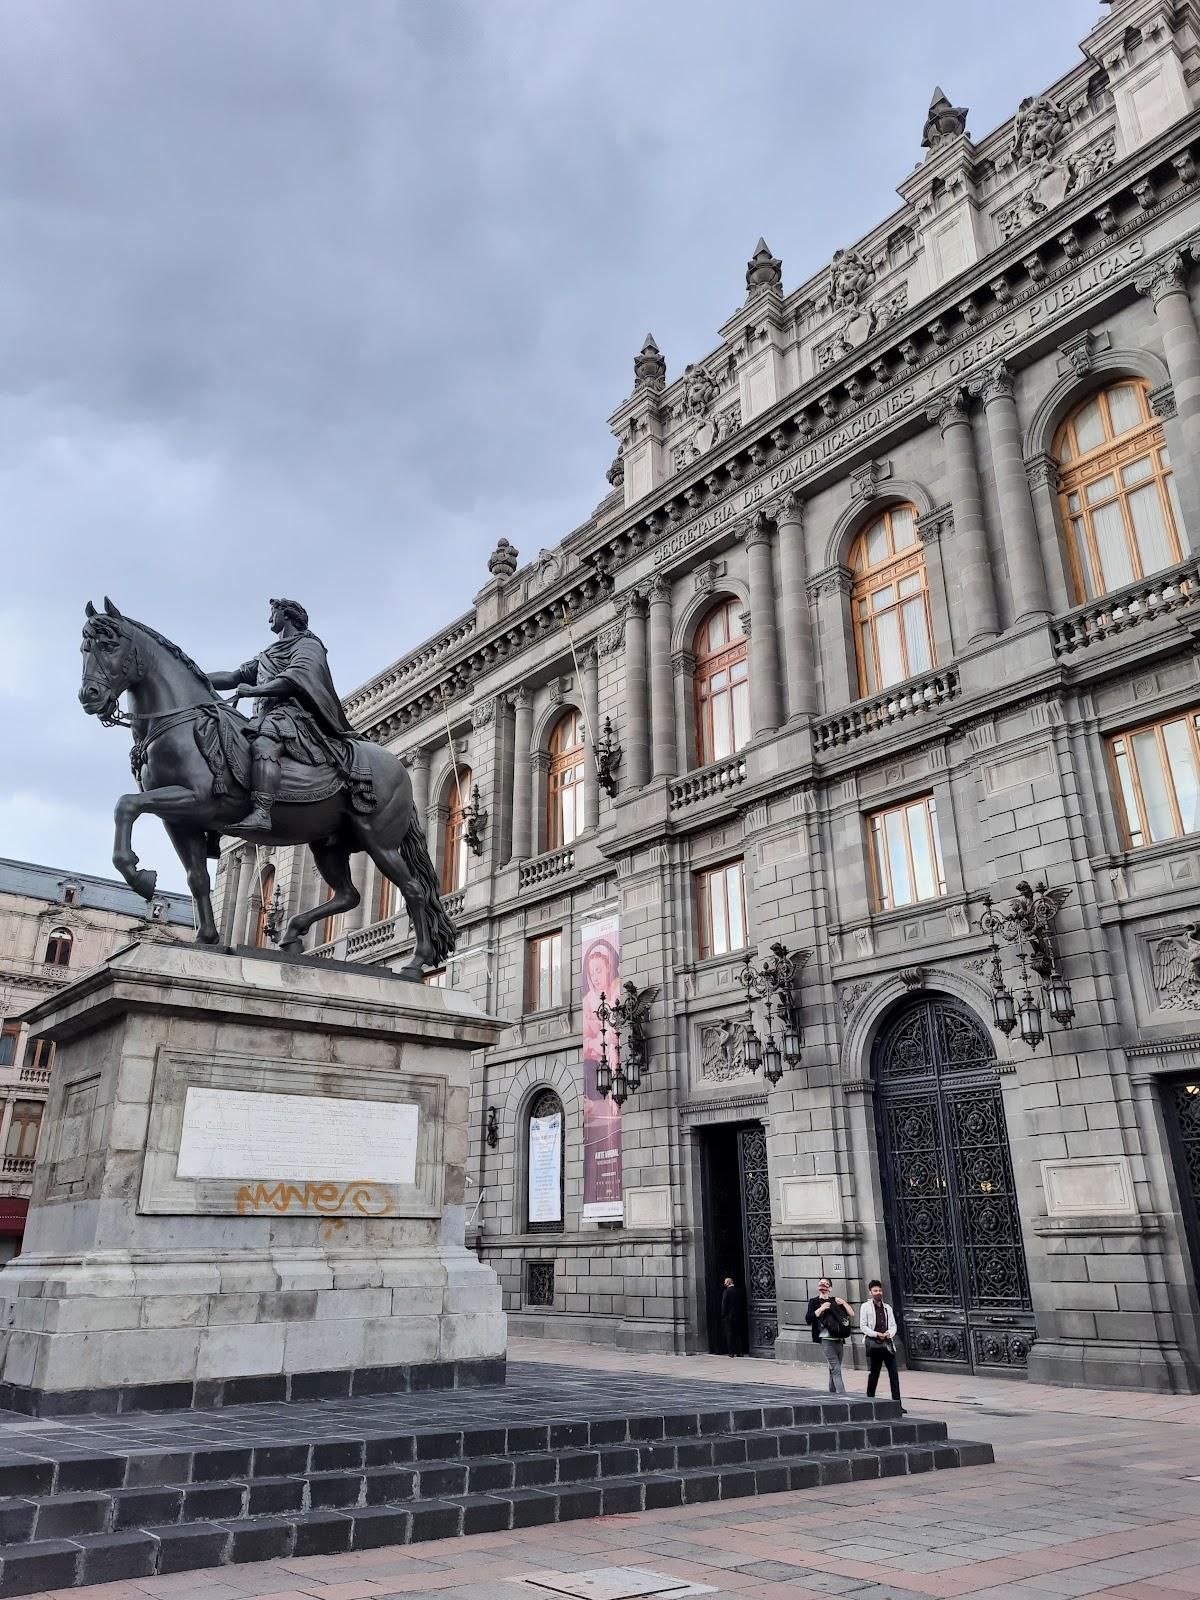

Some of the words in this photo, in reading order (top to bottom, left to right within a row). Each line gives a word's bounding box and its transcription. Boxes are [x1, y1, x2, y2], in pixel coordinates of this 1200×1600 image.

[654, 501, 737, 565] SECRETARIA
[743, 483, 764, 509] DE
[769, 385, 915, 490] COMUNICACIONES
[926, 368, 938, 391] Y
[948, 319, 1017, 377] OBRAS
[1028, 235, 1145, 328] PUBLICAS
